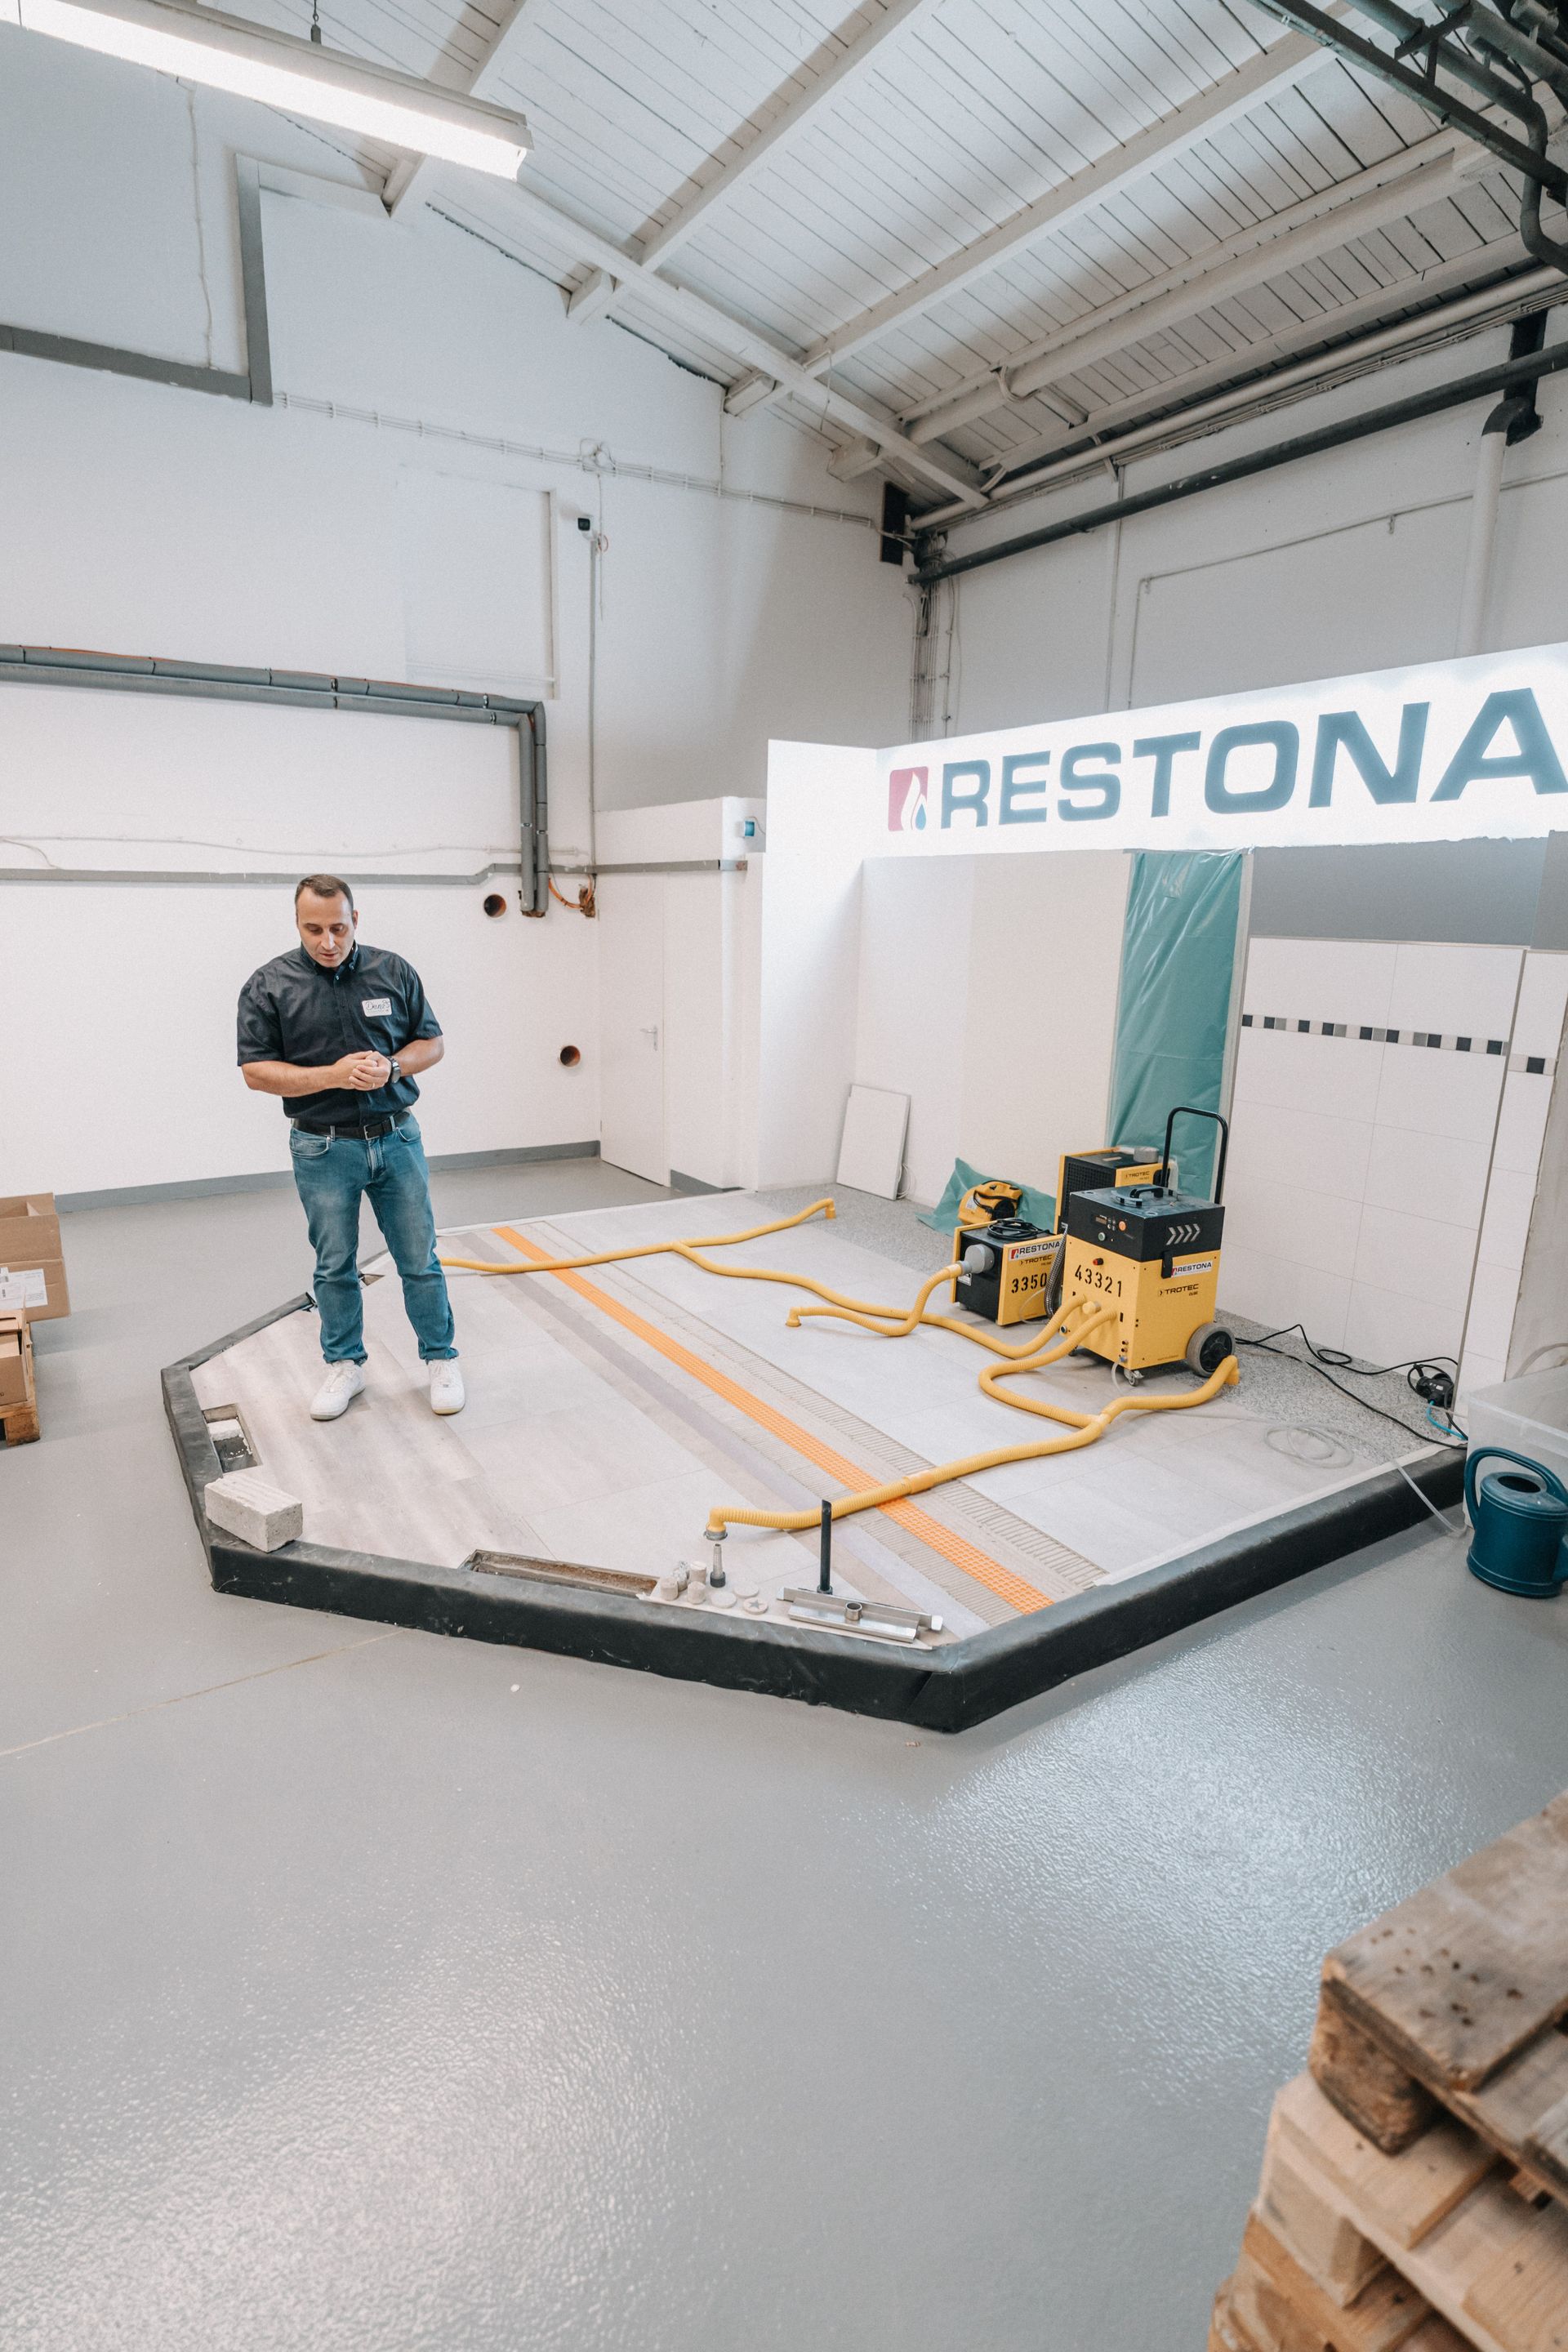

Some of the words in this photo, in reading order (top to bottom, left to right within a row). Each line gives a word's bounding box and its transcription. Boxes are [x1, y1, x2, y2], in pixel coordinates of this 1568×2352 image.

[941, 688, 1568, 829] RESTONA
[1019, 1241, 1060, 1254] RESTONA
[1025, 1254, 1052, 1264] TROTEC
[1178, 1263, 1212, 1272] RESTONA
[1011, 1272, 1047, 1294] 3350
[1075, 1264, 1121, 1297] 43321
[1165, 1284, 1199, 1294] TROTEC
